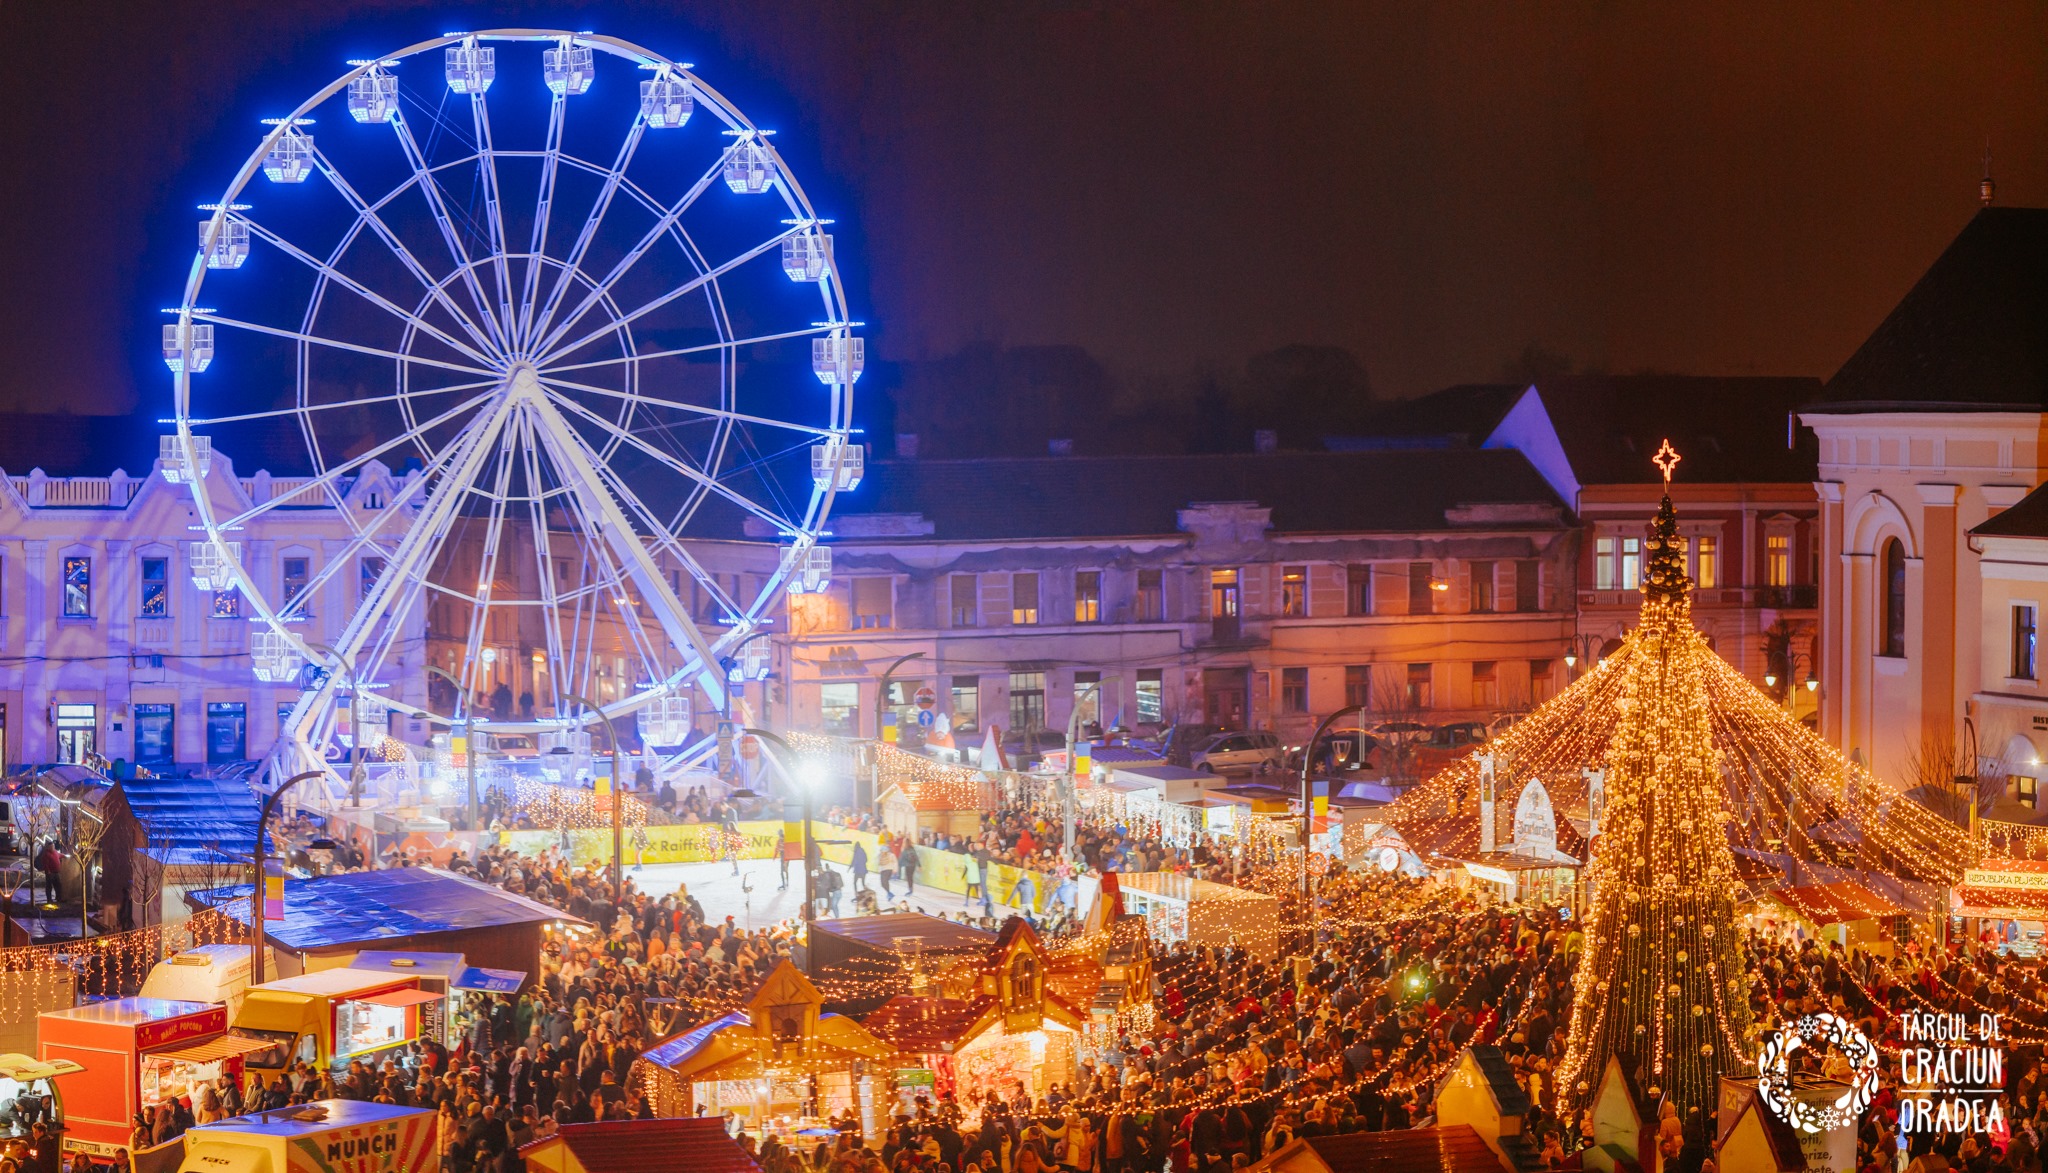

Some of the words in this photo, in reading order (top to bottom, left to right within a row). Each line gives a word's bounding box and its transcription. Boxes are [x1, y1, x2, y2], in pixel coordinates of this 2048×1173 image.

[160, 1024, 178, 1042] MAGIC
[179, 1020, 203, 1033] POPCORN
[327, 1133, 396, 1161] MUNCH
[201, 1156, 230, 1166] MUNCH
